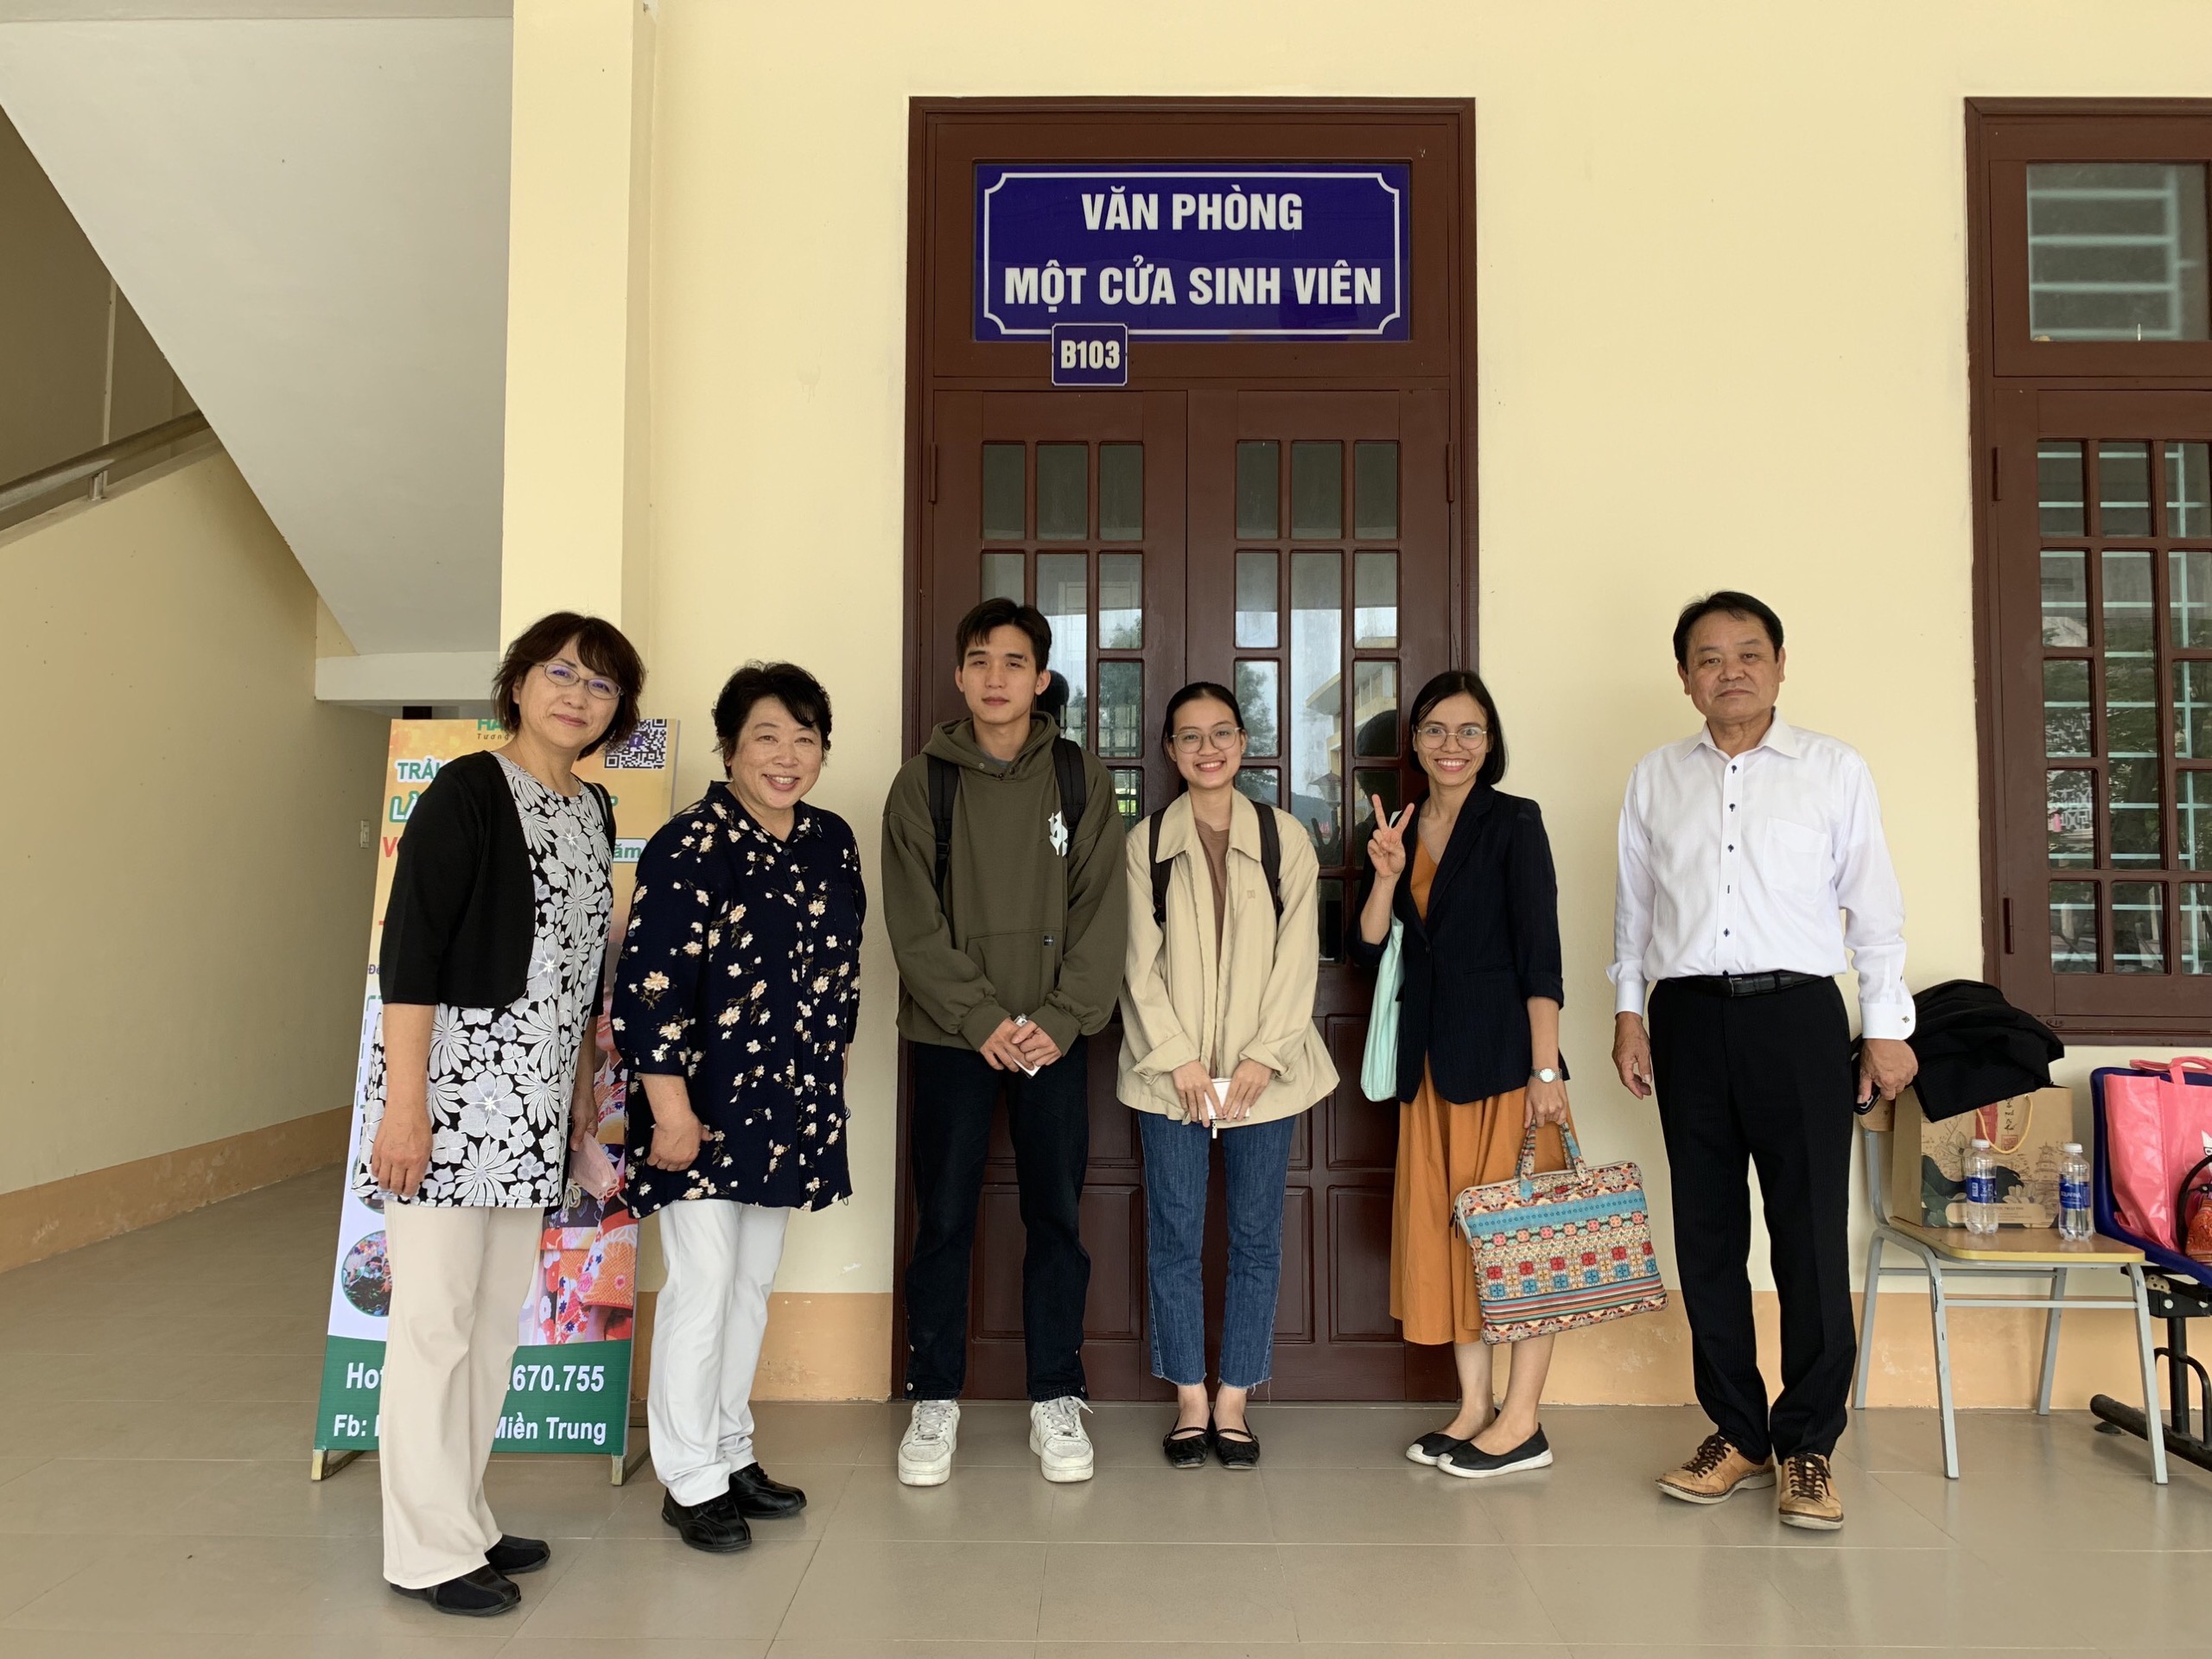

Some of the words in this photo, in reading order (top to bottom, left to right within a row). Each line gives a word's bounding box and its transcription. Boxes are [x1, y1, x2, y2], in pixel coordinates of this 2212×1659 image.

[1082, 185, 1159, 231] VĂN
[1172, 184, 1302, 231] PHÒNG
[1005, 259, 1086, 313] MỘT
[1099, 255, 1177, 305] CỬA
[1189, 267, 1280, 305] SINH
[1293, 259, 1382, 305] VIÊN
[1060, 340, 1121, 370] B103
[334, 1414, 367, 1437] Fb:
[545, 1416, 607, 1446] Trung
